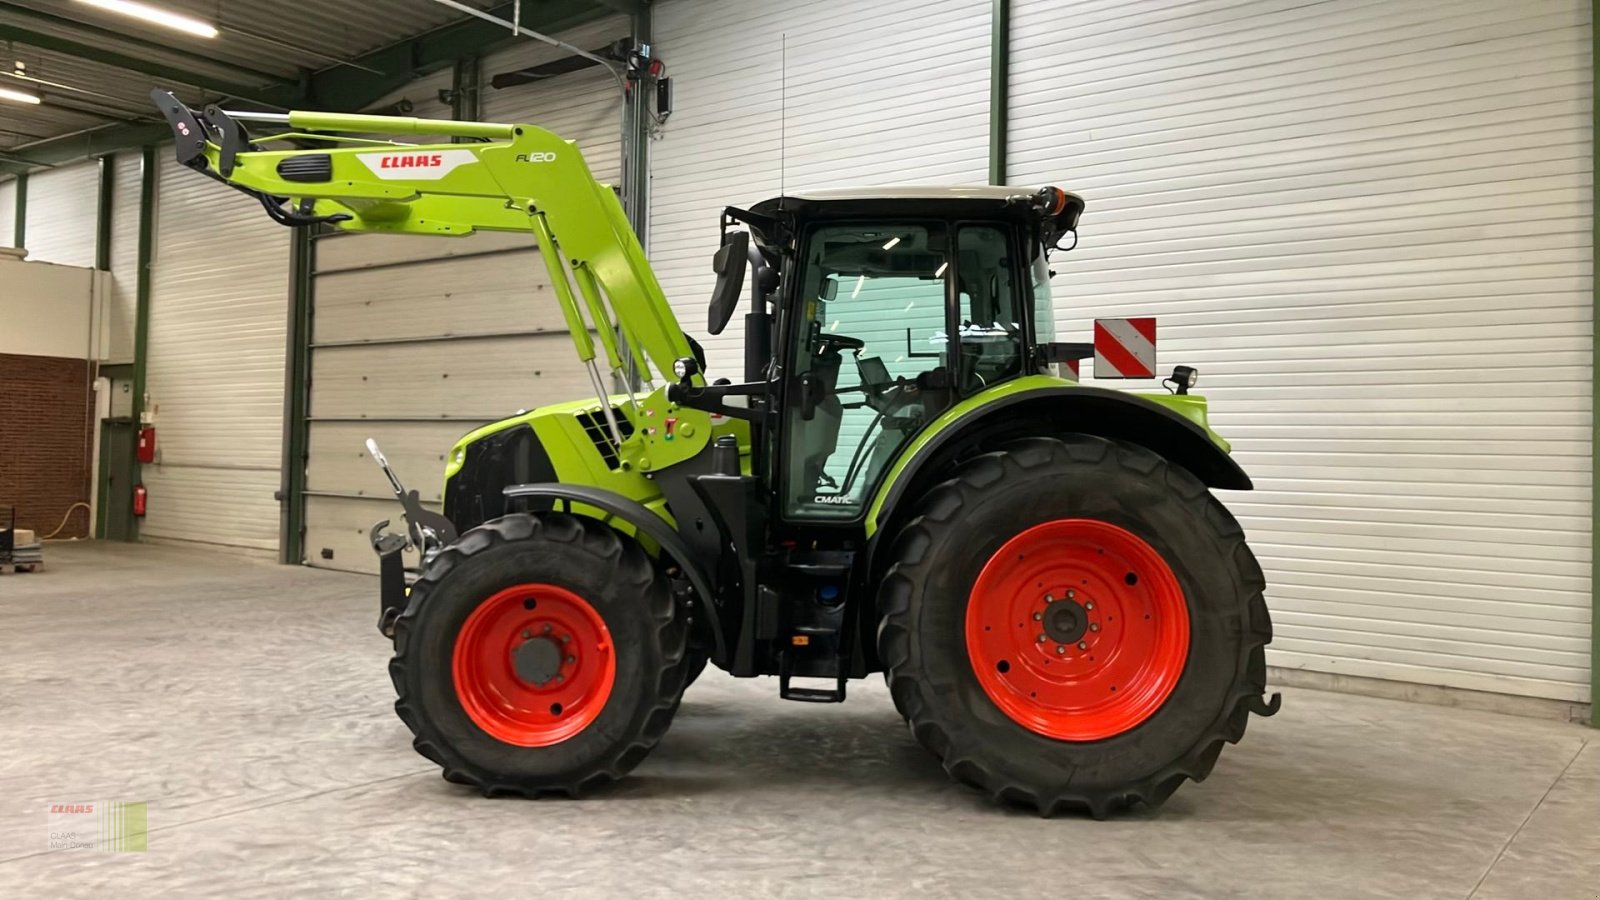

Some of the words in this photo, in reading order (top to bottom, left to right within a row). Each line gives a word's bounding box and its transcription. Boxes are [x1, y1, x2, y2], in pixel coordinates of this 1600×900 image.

[380, 154, 442, 169] CLAAS
[515, 151, 557, 163] FL120
[814, 495, 853, 504] CMATIC
